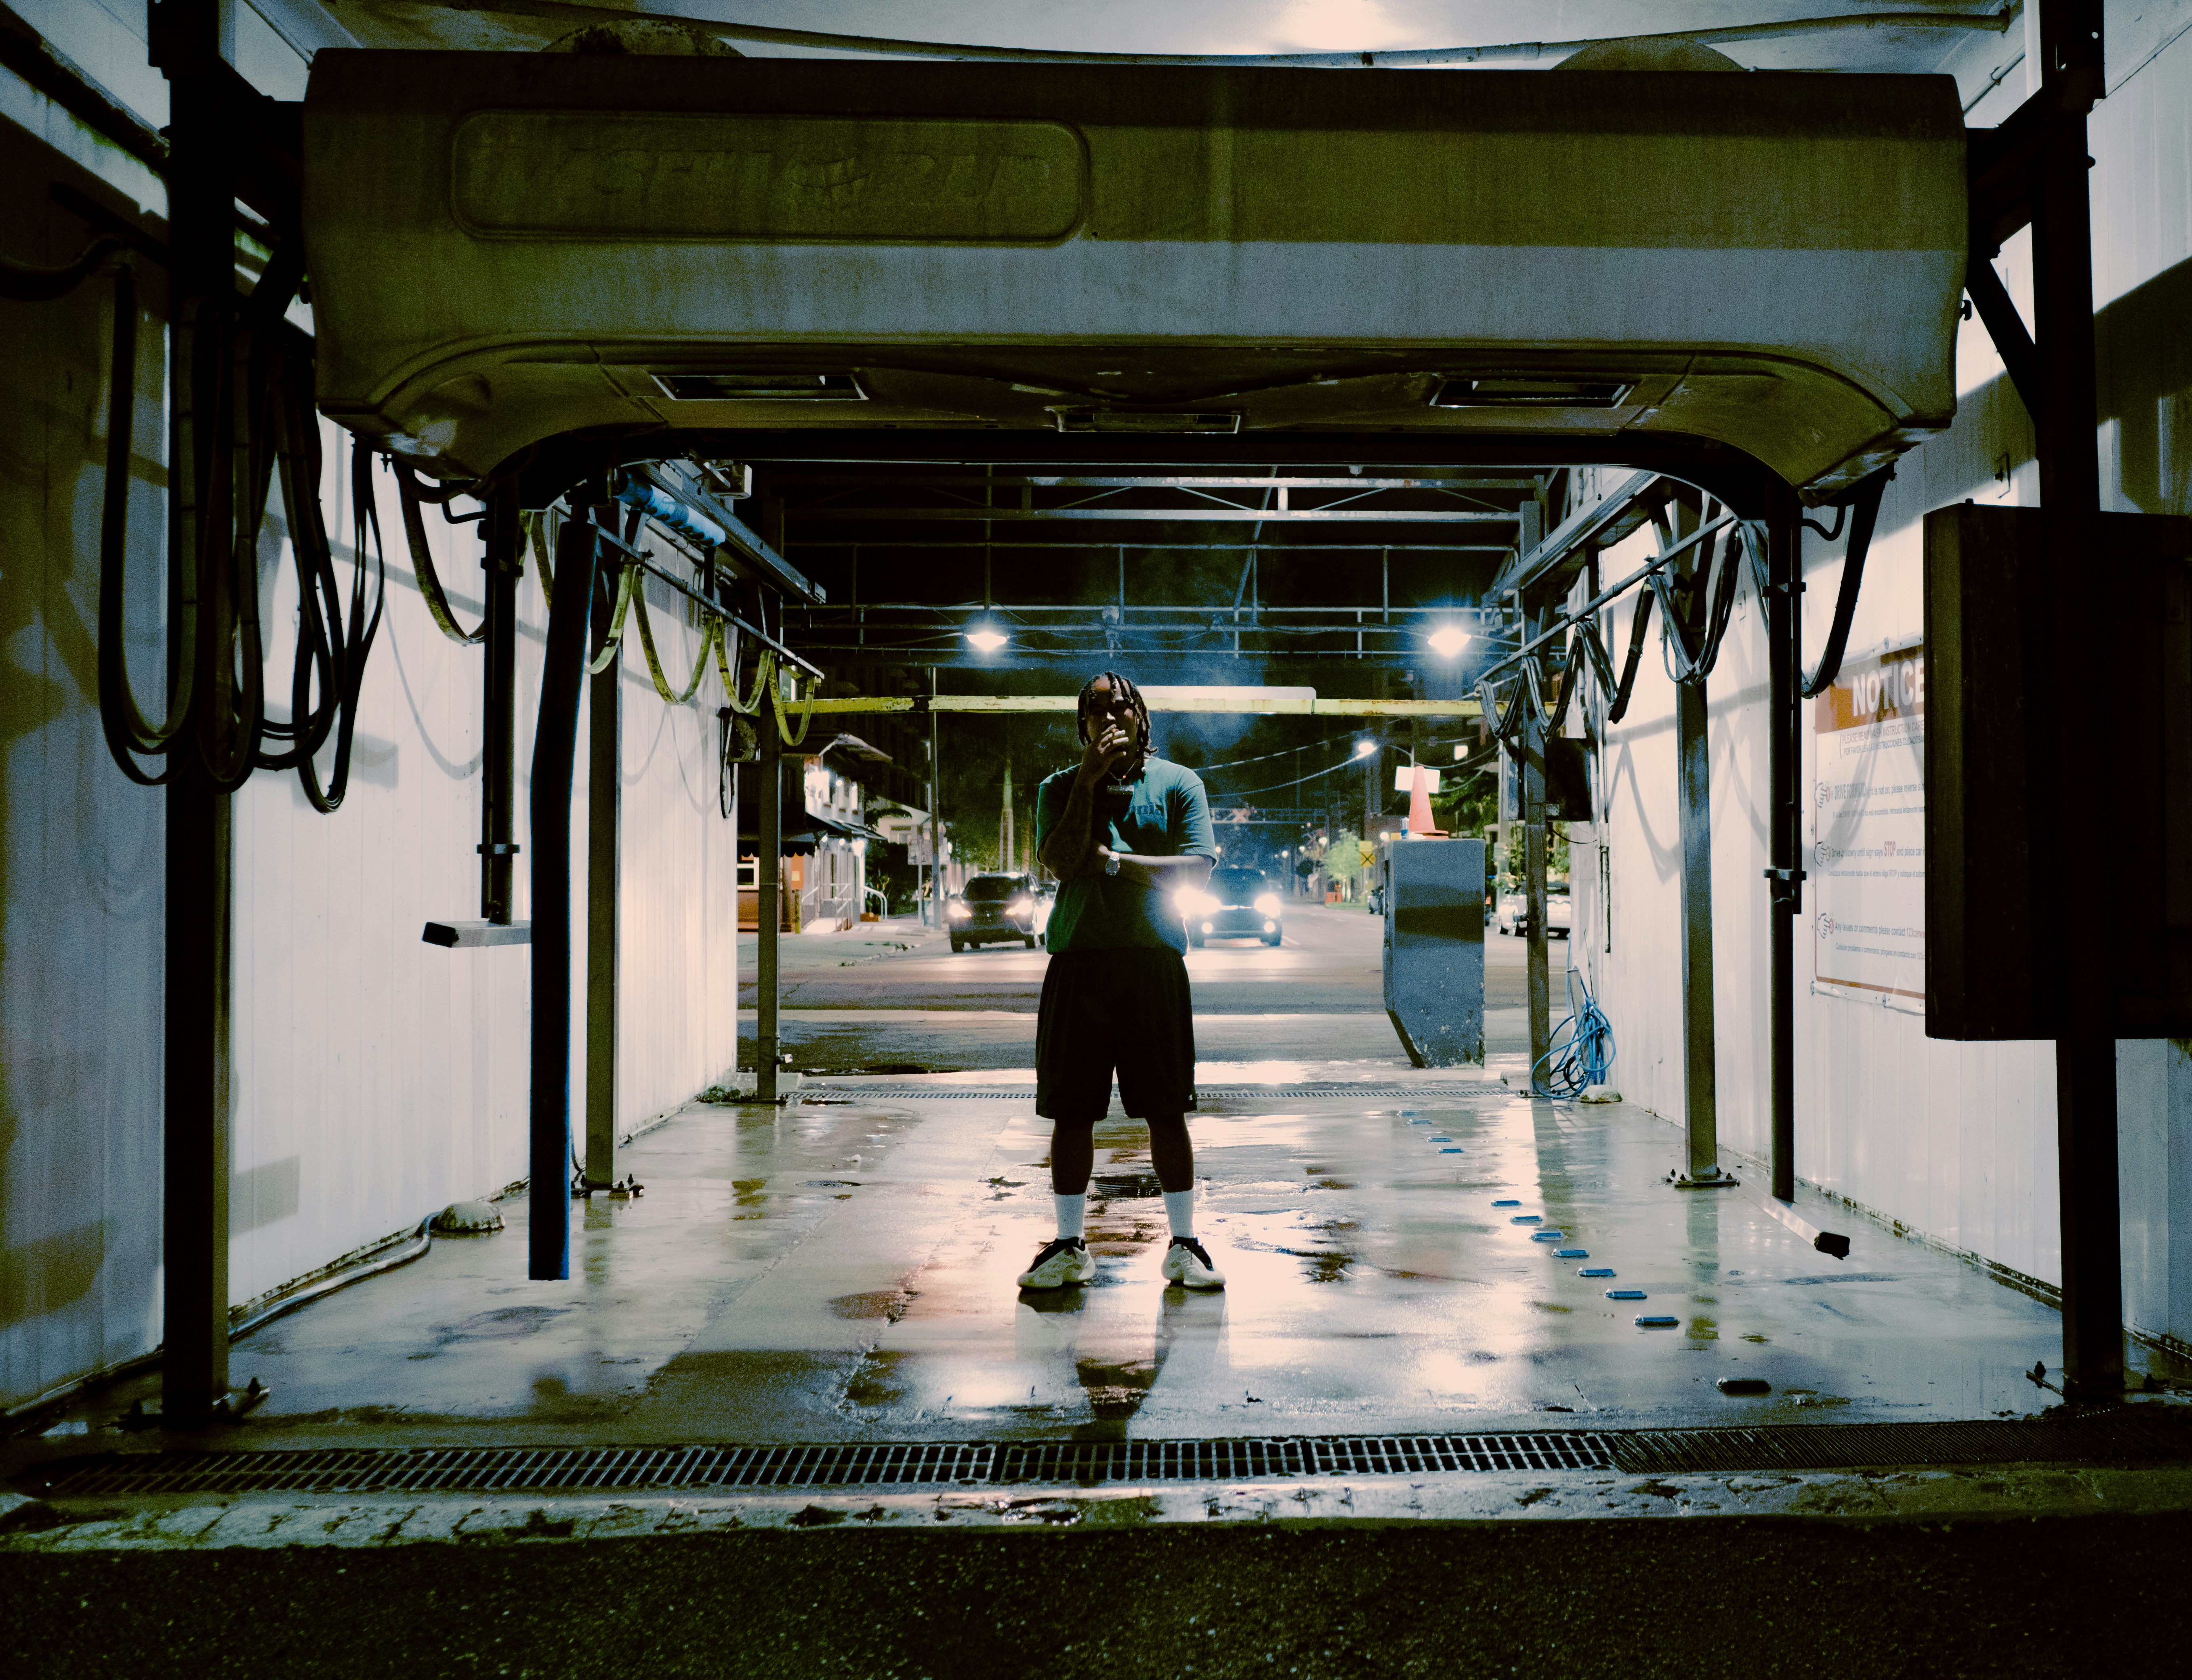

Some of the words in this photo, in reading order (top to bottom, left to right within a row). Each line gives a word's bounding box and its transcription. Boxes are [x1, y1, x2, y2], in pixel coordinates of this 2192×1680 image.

[1853, 657, 1924, 717] NOTICE
[1842, 733, 1858, 744] PLEASE
[1858, 731, 1869, 741] READ
[1870, 727, 1882, 739] WASH
[1883, 722, 1911, 737] INSTRUCTION
[1835, 784, 1846, 800] DRIVE
[1847, 781, 1866, 798] FORWARD
[1875, 785, 1877, 795] is
[1891, 784, 1903, 796] please
[1904, 783, 1917, 792] reverse
[1832, 848, 1841, 857] Drive
[1845, 848, 1856, 859] slowly
[1857, 847, 1865, 857] until
[1875, 849, 1883, 859] says
[1884, 841, 1896, 857] STOP
[1905, 846, 1915, 858] place
[1843, 922, 1853, 932] issues
[1859, 925, 1878, 934] comments
[1879, 925, 1890, 936] please
[1891, 927, 1906, 937] contact
